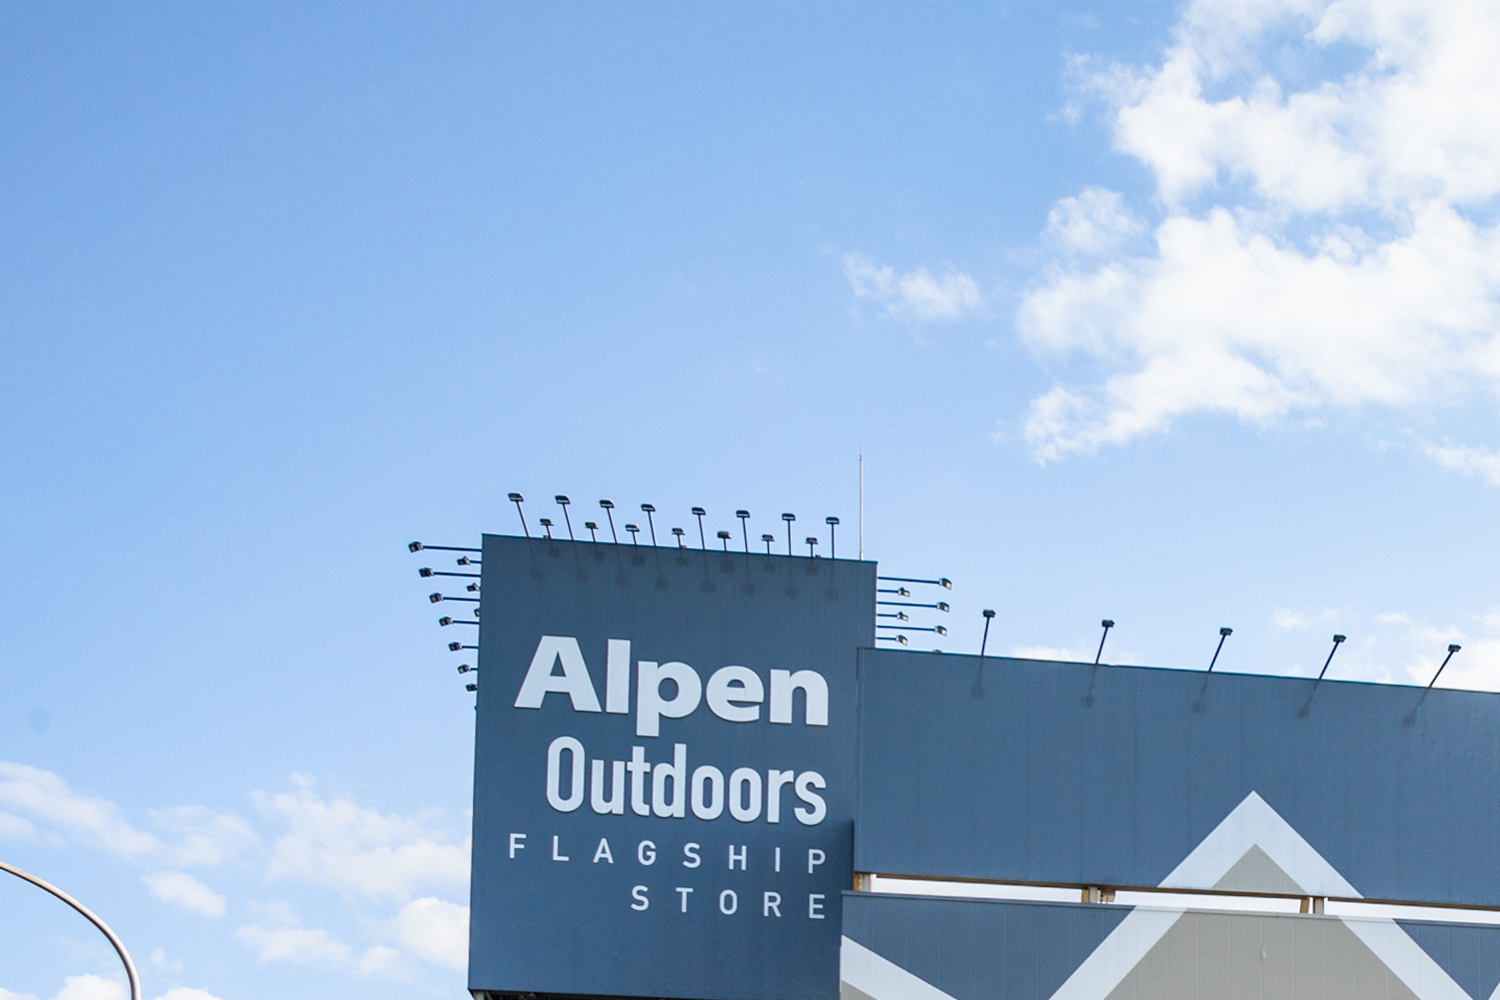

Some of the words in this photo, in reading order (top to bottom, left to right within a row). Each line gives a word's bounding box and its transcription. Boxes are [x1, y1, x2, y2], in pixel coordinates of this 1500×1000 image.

[514, 635, 829, 737] Alpen
[546, 736, 827, 826] Outdoors
[508, 833, 827, 874] FLAGSHIP
[630, 885, 826, 919] STORE
